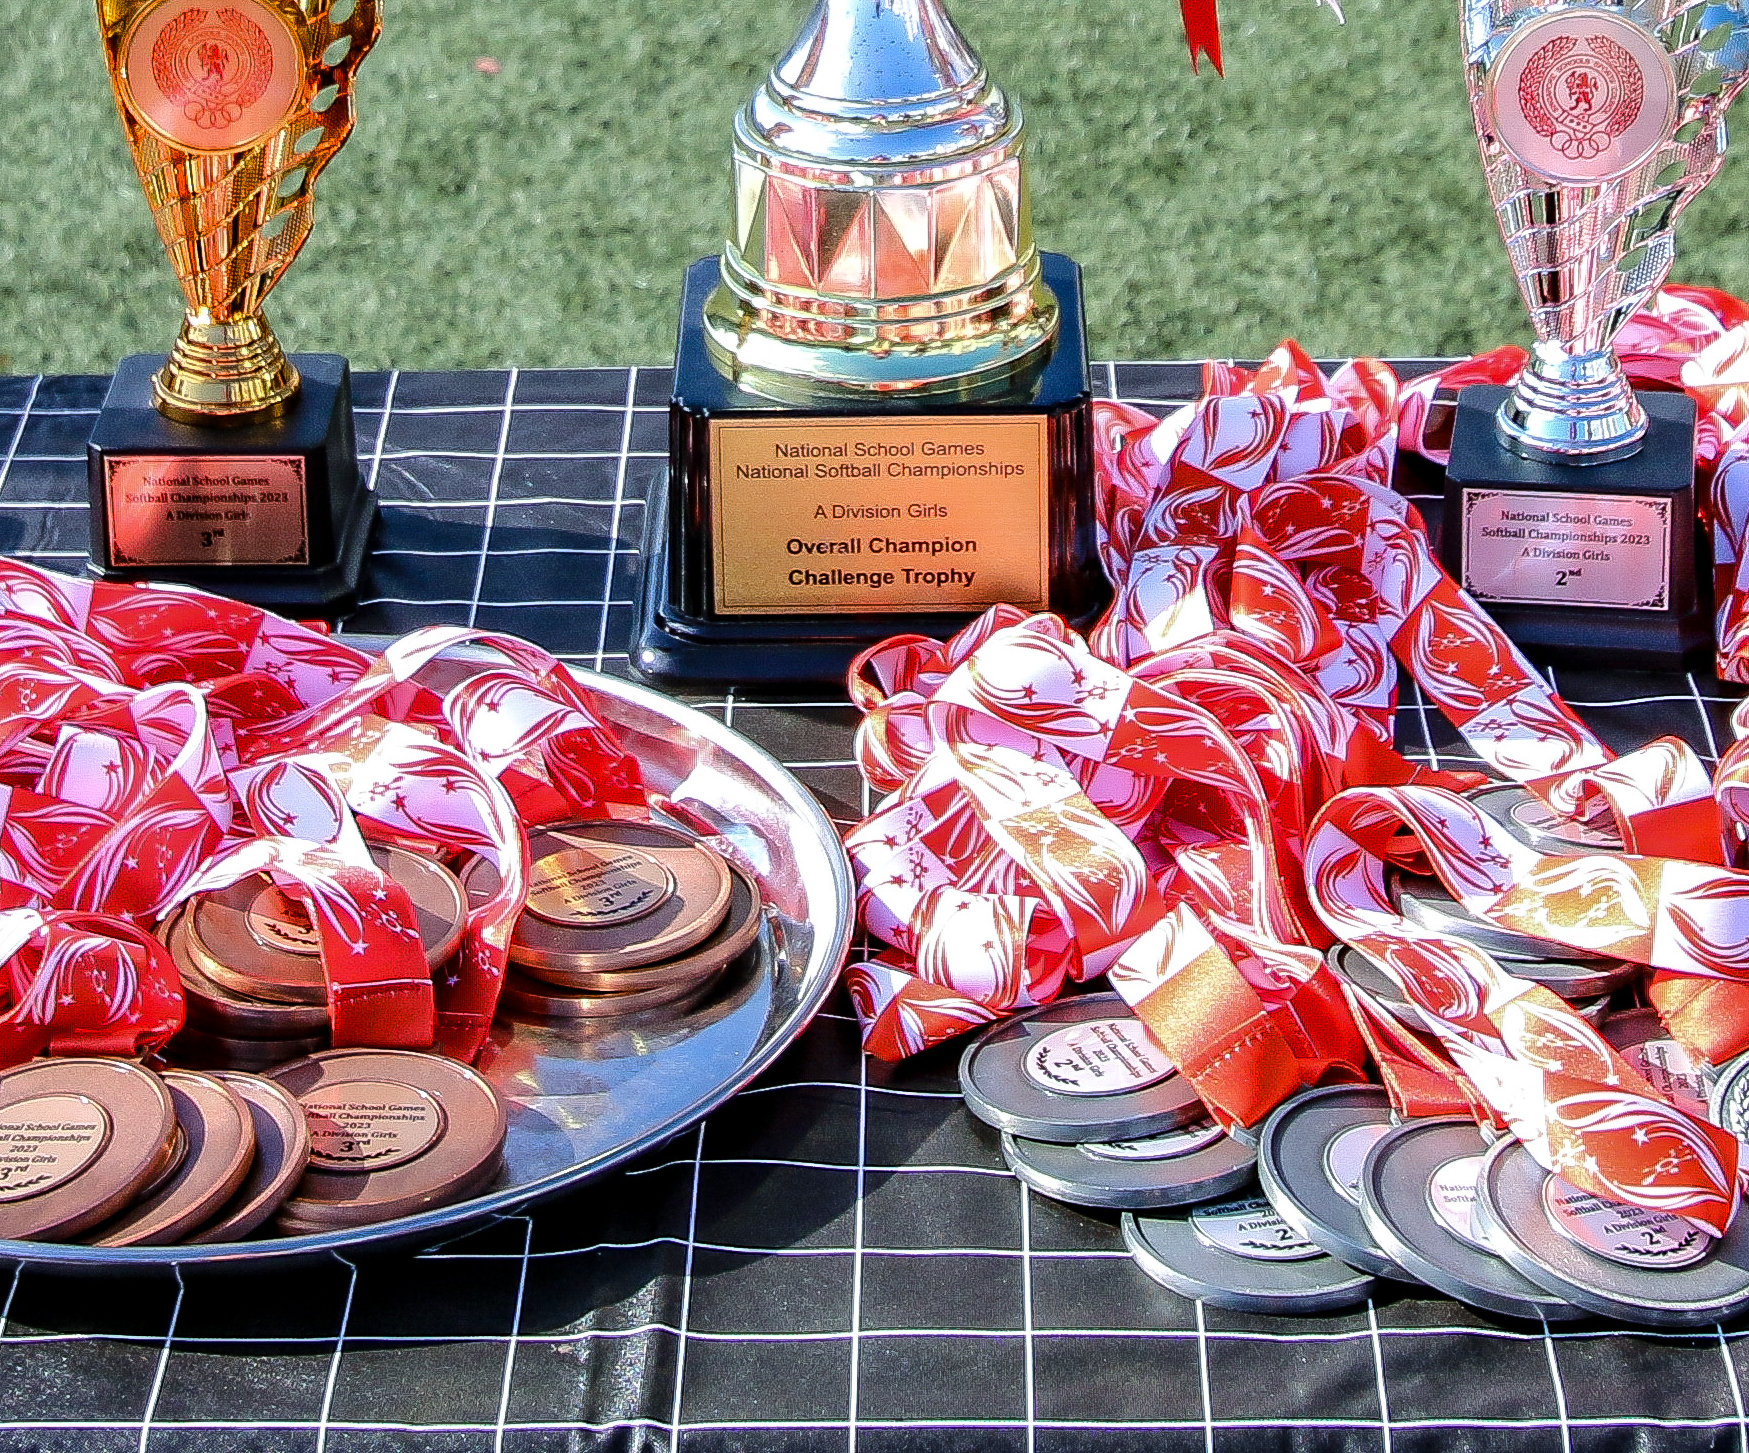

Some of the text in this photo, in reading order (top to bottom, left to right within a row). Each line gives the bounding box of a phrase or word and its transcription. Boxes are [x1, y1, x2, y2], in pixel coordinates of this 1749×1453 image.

[775, 441, 985, 458] National School Games
[736, 461, 1024, 479] National Softball Championships
[143, 476, 270, 486] National School Games
[125, 493, 289, 505] Softball Championships 2023
[166, 510, 251, 520] A Division Girls
[814, 503, 948, 519] A Division Girls
[1501, 511, 1633, 527] National School Games
[201, 528, 225, 547] 3rd
[1481, 527, 1650, 545] Softball Championships 2023
[786, 537, 978, 557] Overall Champion
[1521, 548, 1611, 561] A Division Girls
[788, 568, 976, 589] Challenge Trophy
[1555, 568, 1582, 586] 2nd
[25, 1123, 59, 1131] School
[61, 1123, 97, 1131] Games
[11, 1134, 92, 1143] Championships
[9, 1145, 39, 1153] 2023
[31, 1155, 57, 1163] Girls
[1238, 1223, 1247, 1231] A
